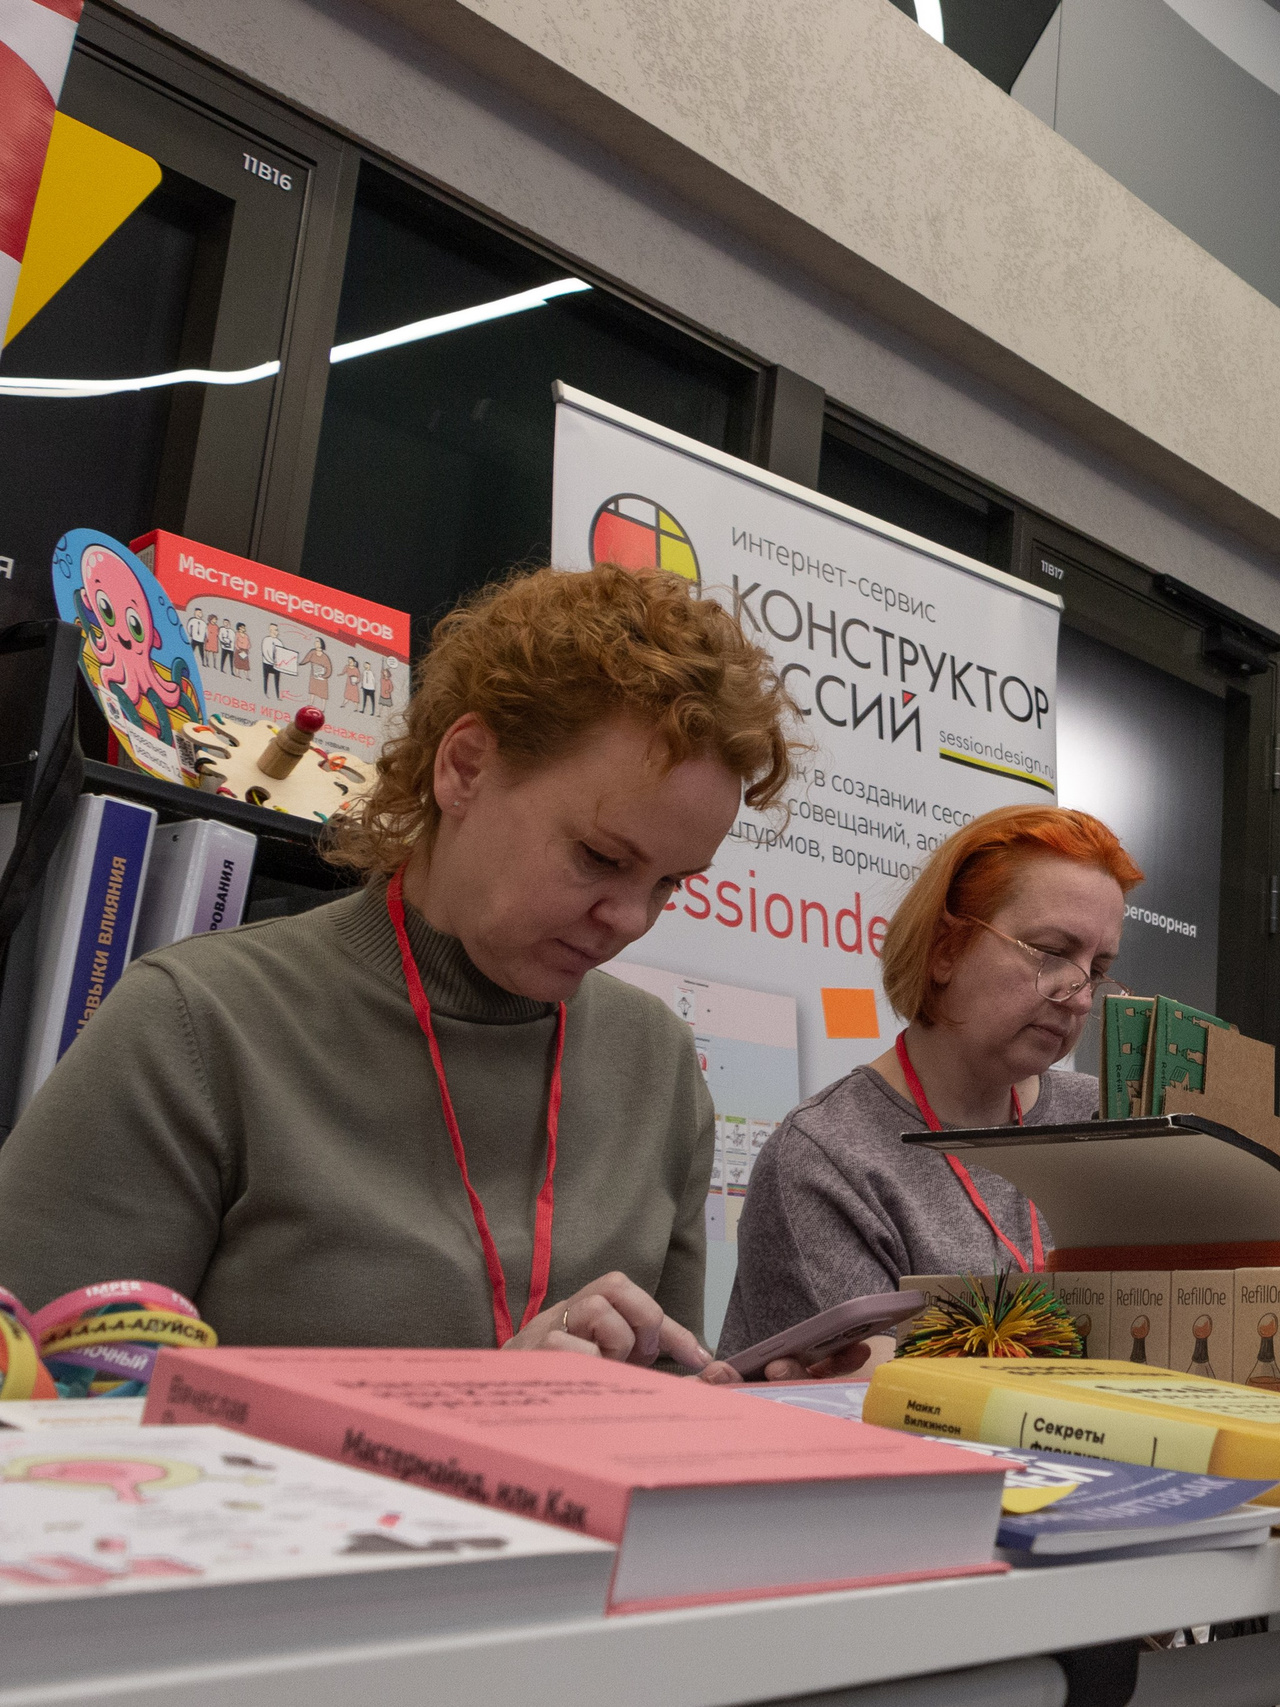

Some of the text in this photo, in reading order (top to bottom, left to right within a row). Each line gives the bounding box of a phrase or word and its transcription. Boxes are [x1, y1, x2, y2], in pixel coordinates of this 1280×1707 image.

[242, 152, 292, 191] 11B16
[731, 526, 936, 623] интернет-сервис
[1041, 559, 1065, 580] 11B17
[178, 553, 394, 641] Мастер переговоров
[732, 574, 1050, 730] КОНСТРУКТОР
[768, 655, 921, 752] ССИЙ
[261, 706, 291, 723] игра
[320, 723, 376, 748] енажер
[939, 730, 1055, 779] sessiondesign.ru
[814, 769, 826, 788] в
[832, 775, 927, 817] создании
[787, 798, 910, 849] совещаний,
[1059, 1287, 1105, 1306] RefillOne
[1116, 1288, 1164, 1306] RefillOne
[1177, 1287, 1227, 1306] RefillOne
[903, 1413, 962, 1436] Вилкинсон
[906, 1399, 942, 1416] Майкл
[1033, 1416, 1106, 1446] Секреты
